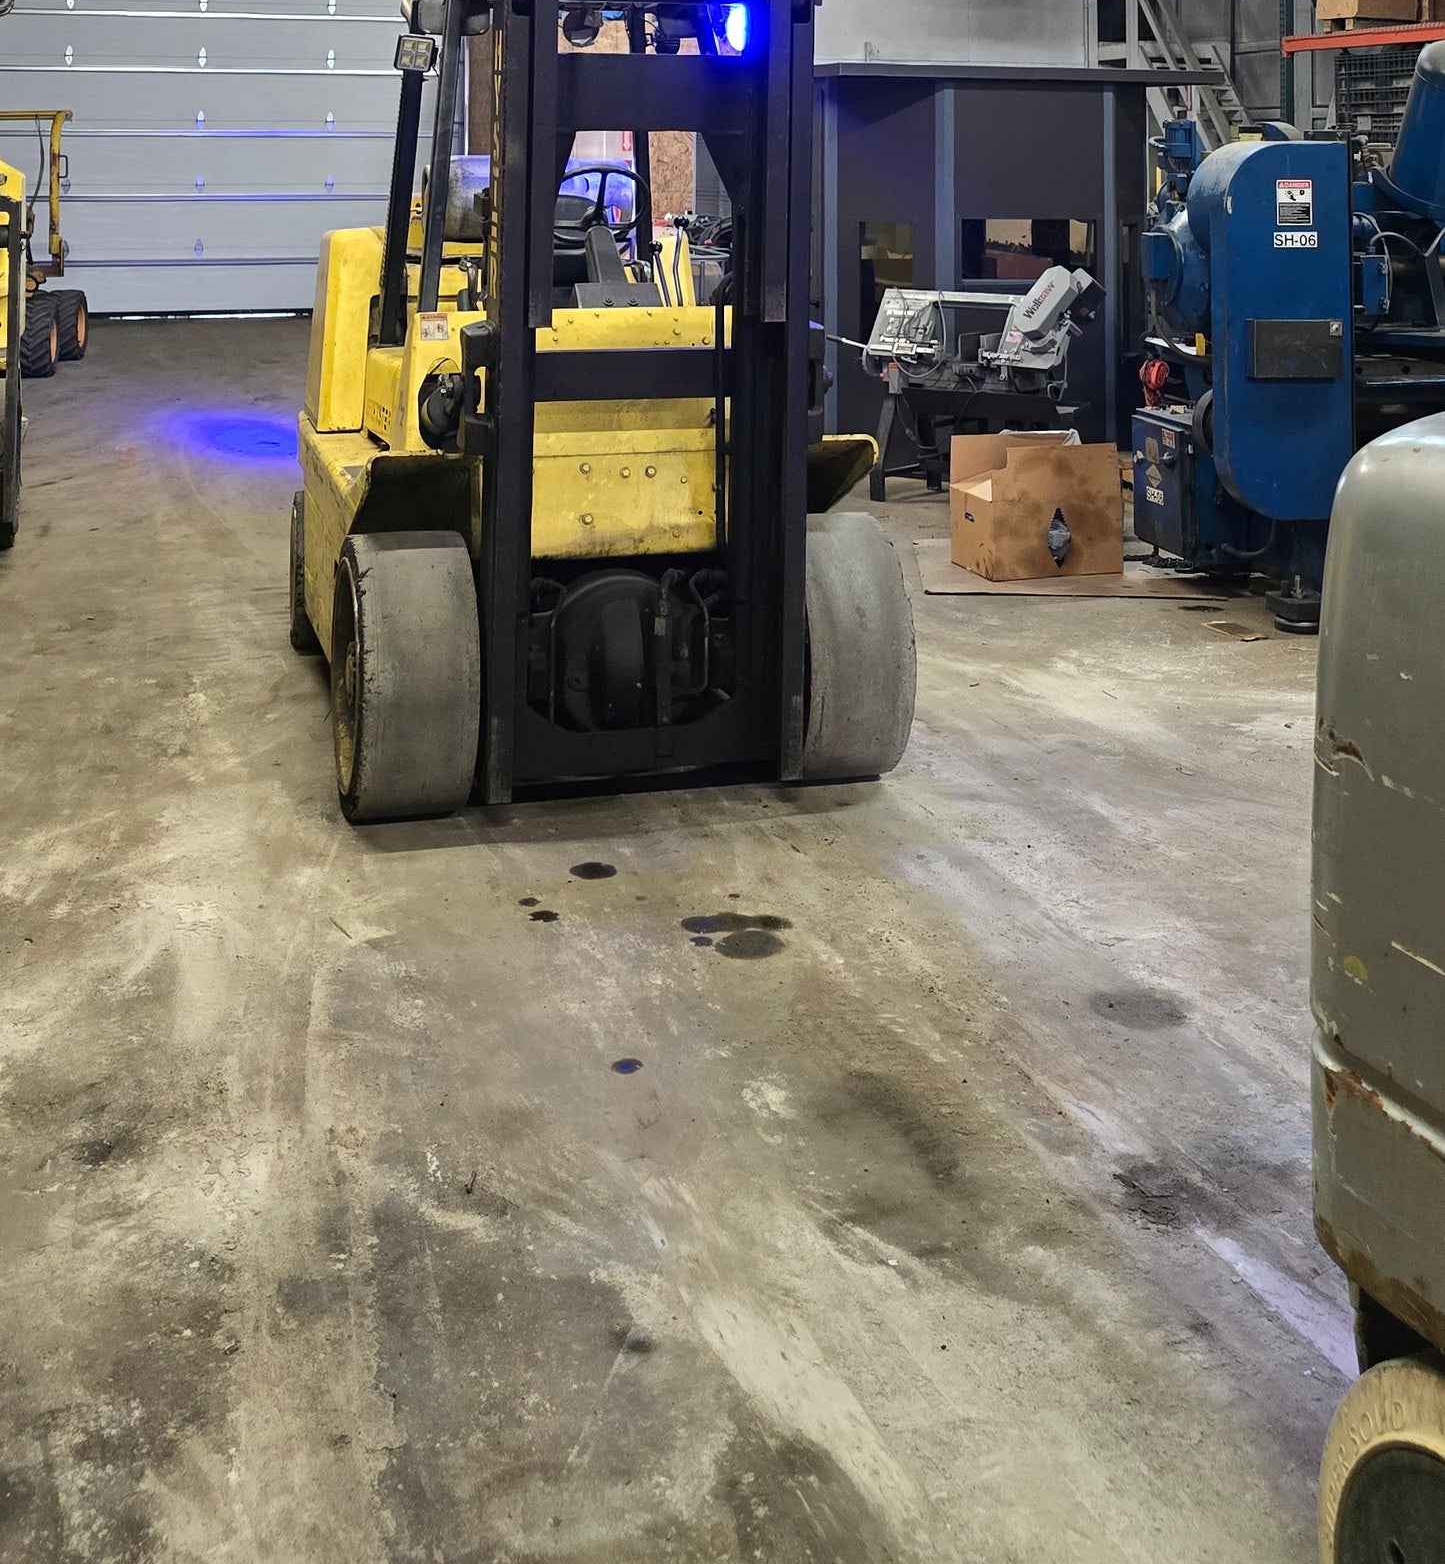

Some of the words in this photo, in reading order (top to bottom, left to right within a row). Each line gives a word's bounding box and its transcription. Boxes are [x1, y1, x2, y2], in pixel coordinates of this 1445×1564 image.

[489, 29, 503, 301] HYSTER
[1274, 234, 1316, 246] SH-06
[1349, 1400, 1406, 1456] SOLID
